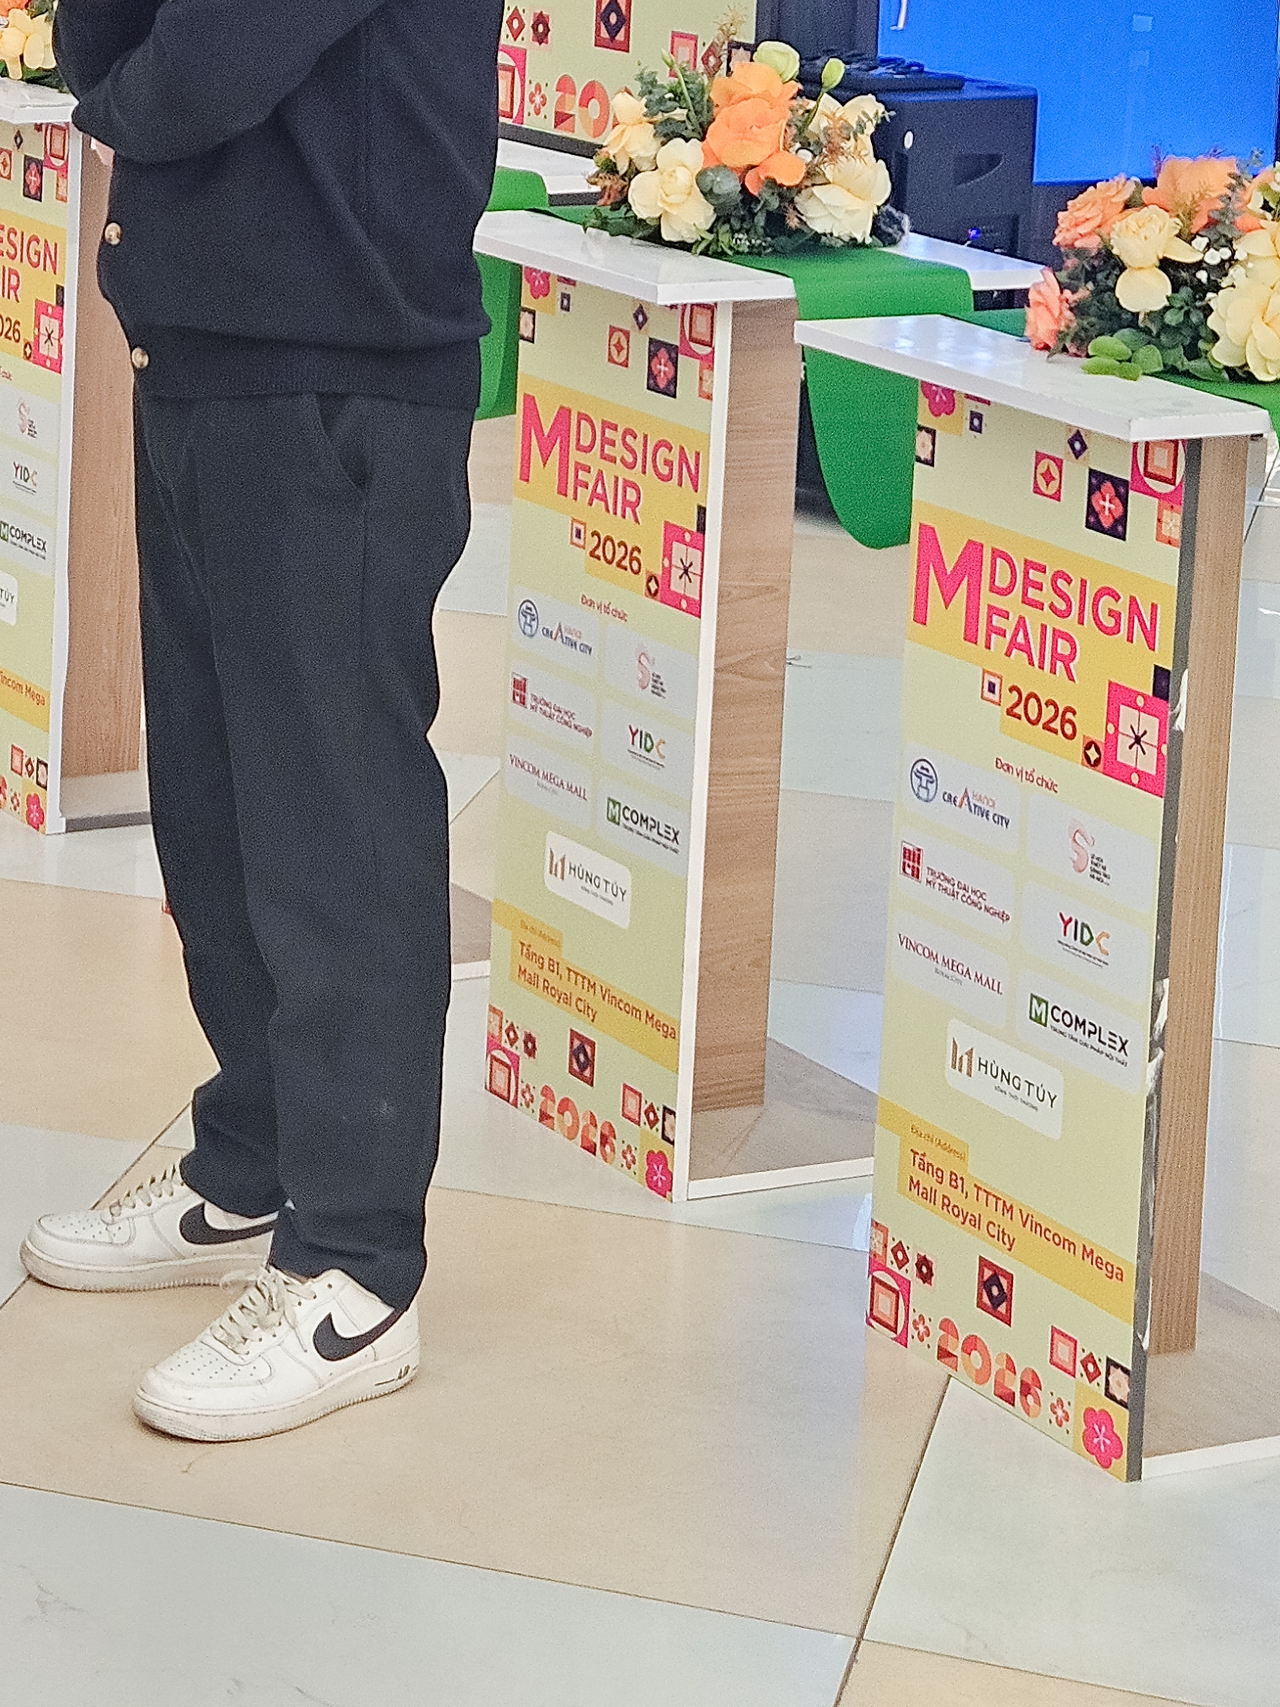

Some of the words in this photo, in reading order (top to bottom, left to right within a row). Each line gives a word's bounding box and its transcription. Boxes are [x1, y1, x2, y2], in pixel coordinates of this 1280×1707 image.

[12, 461, 38, 486] YIDC
[519, 392, 572, 498] M
[574, 410, 701, 494] DESIGN
[572, 461, 643, 525] FAIR
[589, 529, 643, 576] 2026
[913, 522, 984, 646] M
[989, 546, 1160, 653] DESIGN
[984, 603, 1078, 683] FAIR
[1005, 684, 1078, 741] 2026
[628, 724, 666, 760] YIDC
[542, 769, 564, 790] MEGA
[995, 757, 1014, 774] Đơn
[1015, 766, 1024, 783] vị
[1024, 768, 1035, 783] tổ
[1036, 774, 1059, 793] chức
[622, 805, 680, 845] COMPLEX
[992, 812, 1010, 829] CITY
[569, 861, 601, 889] HÙNG
[603, 878, 627, 902] TÚY
[961, 893, 983, 911] CÔNG
[970, 885, 988, 902] HỌC
[1059, 911, 1111, 956] YIDC
[519, 940, 545, 970] Tầng
[548, 958, 562, 980] B1,
[566, 966, 597, 997] TTTM
[600, 985, 642, 1023] Vincom
[644, 1009, 677, 1039] Mega
[898, 932, 939, 964] VINCOM
[941, 955, 972, 981] MEGA
[973, 970, 1003, 996] MALL
[517, 964, 539, 989] Mall
[542, 978, 572, 1007] Royal
[575, 997, 598, 1023] City
[1030, 995, 1048, 1025] M
[1050, 1004, 1129, 1057] COMPLEX
[978, 1056, 1021, 1091] HÙNG
[1024, 1079, 1058, 1109] TÚY
[538, 1084, 617, 1166] 2026
[908, 1175, 937, 1205] Mall
[941, 1195, 981, 1231] Royal
[986, 1221, 1016, 1252] City
[910, 1149, 944, 1183] Tầng
[948, 1170, 969, 1199] B1,
[973, 1182, 1014, 1221] TTTM
[1019, 1208, 1077, 1256] Vincom
[1081, 1249, 1125, 1283] Mega
[936, 1317, 1042, 1419] 2026
